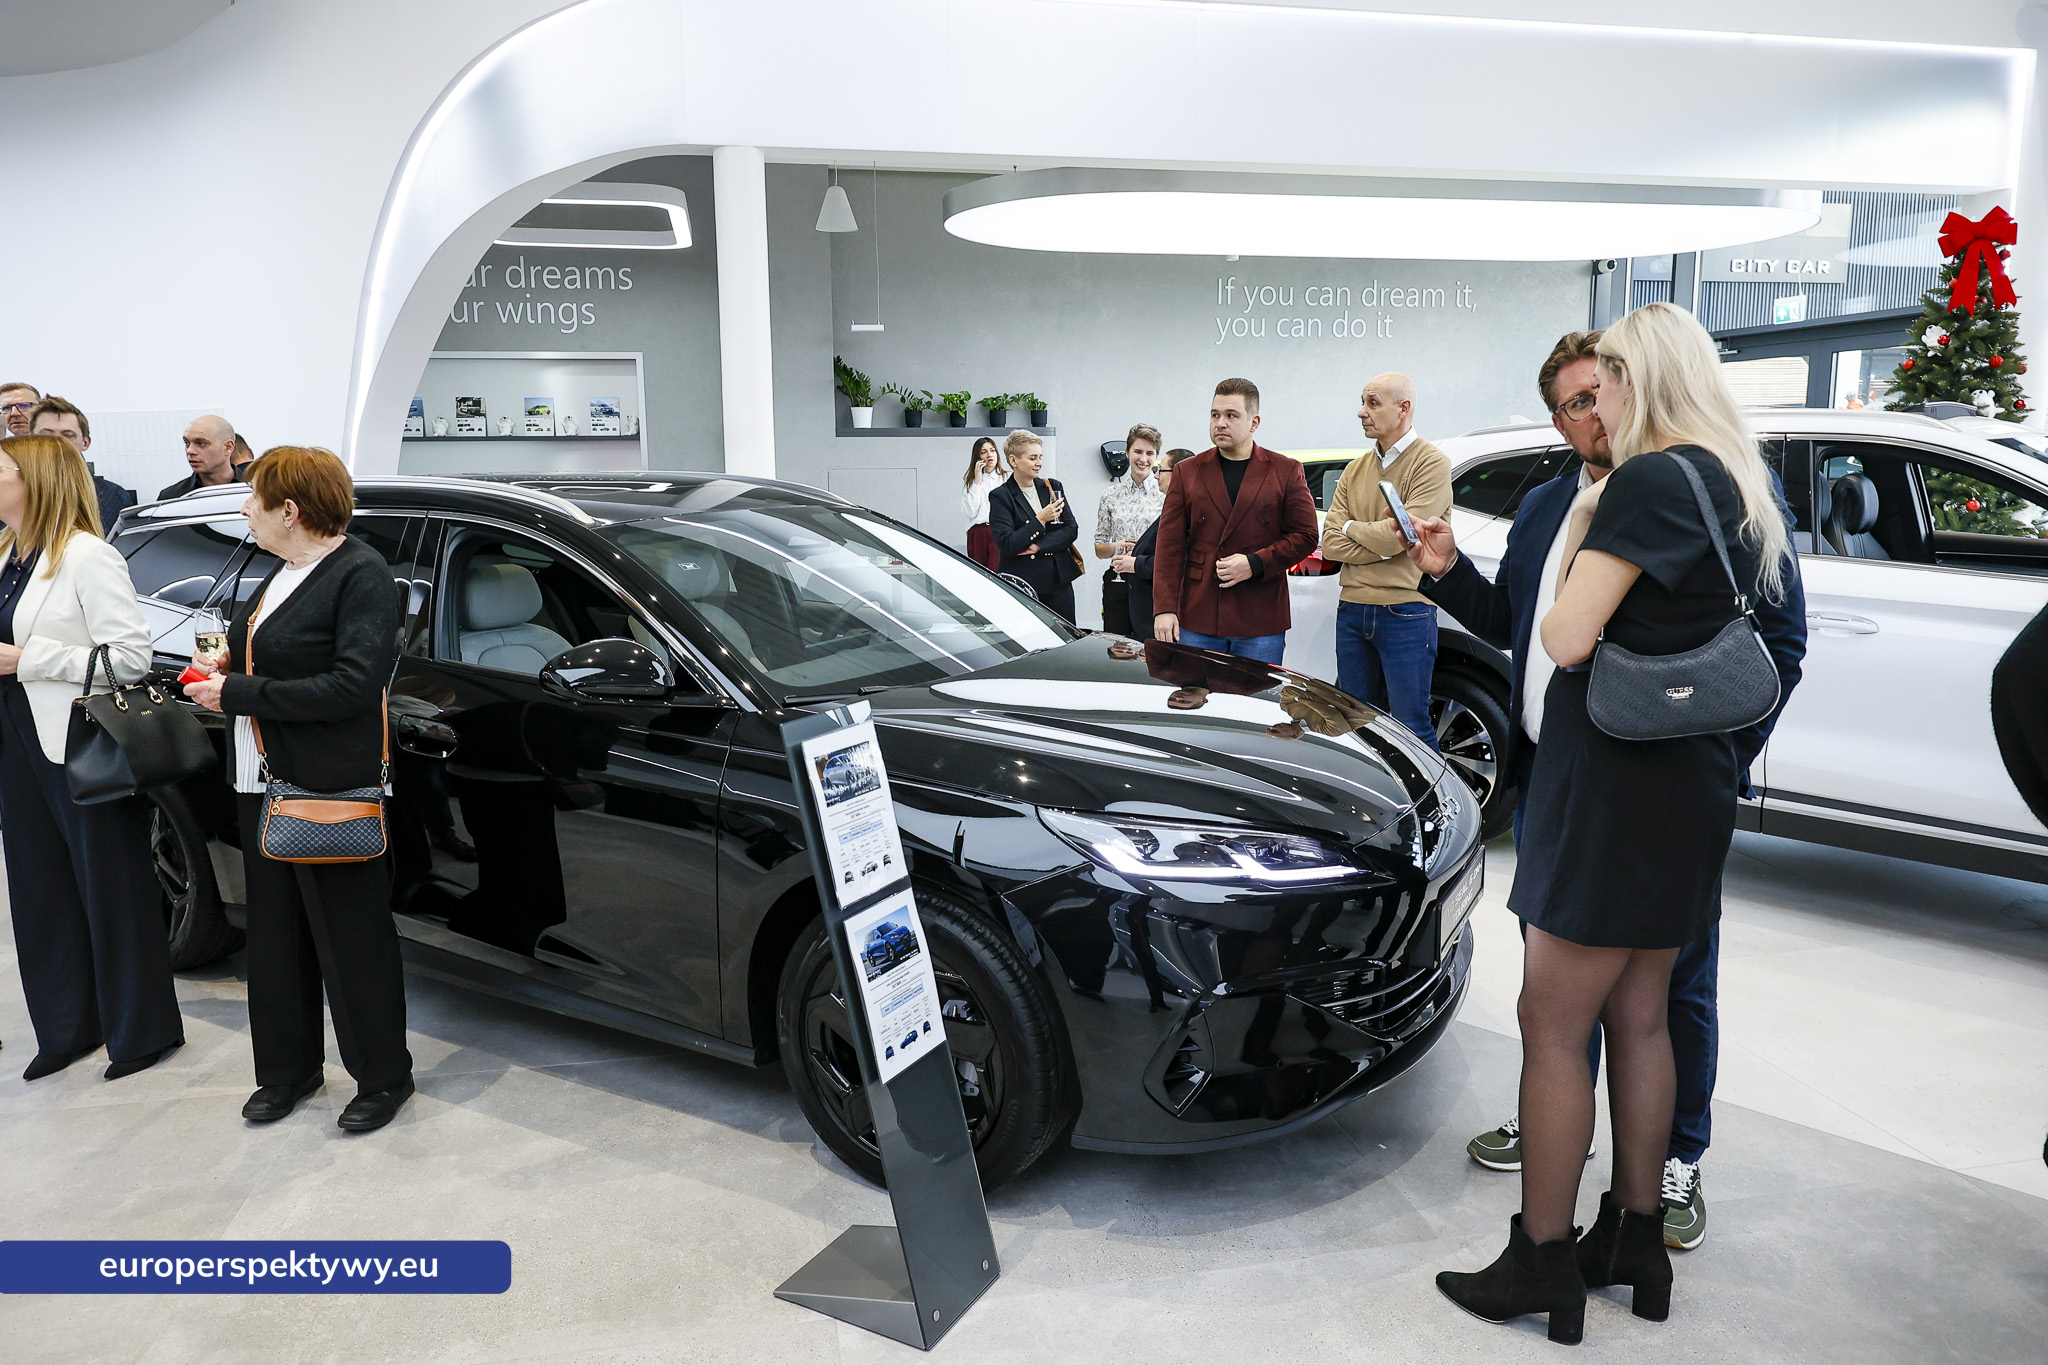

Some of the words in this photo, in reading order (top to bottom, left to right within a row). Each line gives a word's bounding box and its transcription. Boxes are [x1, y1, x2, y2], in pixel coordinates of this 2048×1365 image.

[505, 255, 633, 290] dreams
[1731, 258, 1780, 273] CITY
[1786, 259, 1831, 274] CAR
[1217, 276, 1236, 305] If
[1243, 284, 1294, 314] you
[1304, 284, 1351, 307] can
[1361, 279, 1446, 308] dream
[1455, 281, 1478, 312] it,
[495, 292, 597, 334] wings
[1215, 316, 1266, 345] you
[1276, 316, 1322, 338] can
[1332, 310, 1367, 338] do
[1376, 311, 1394, 339] it
[1665, 686, 1694, 697] GUESS
